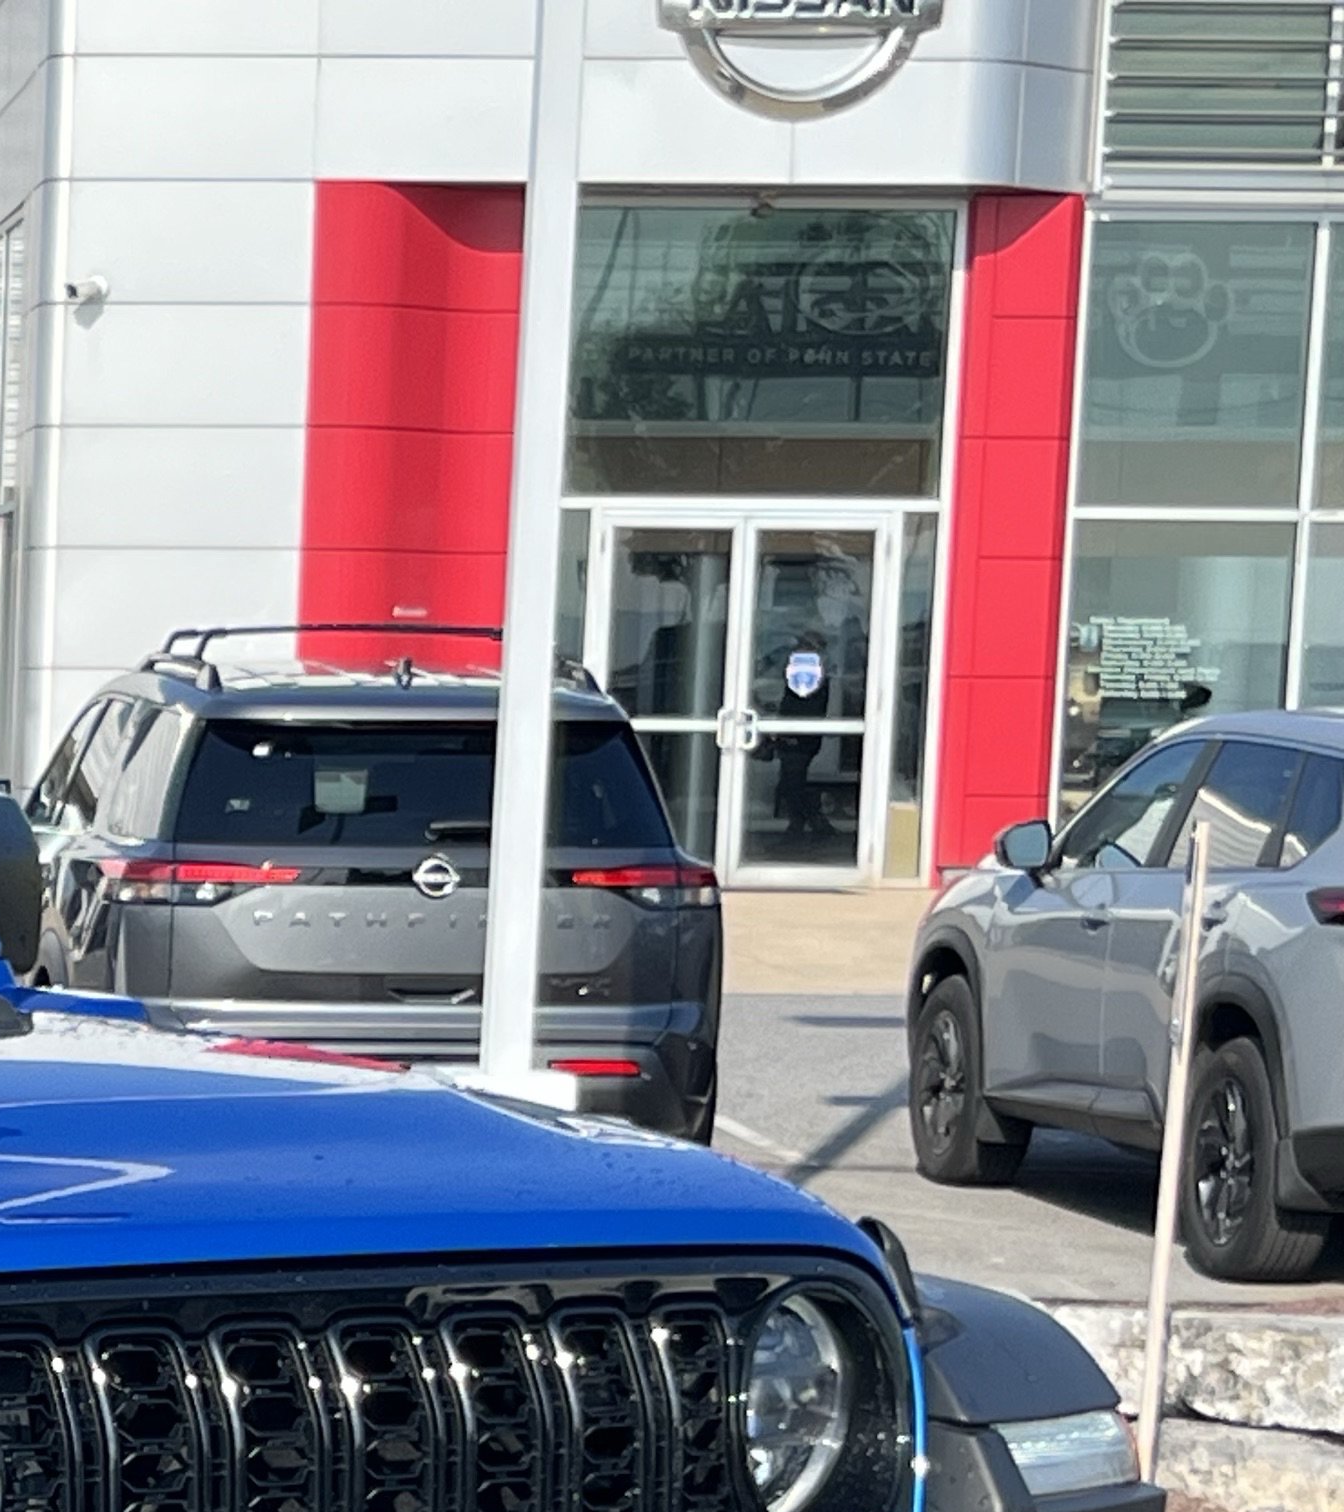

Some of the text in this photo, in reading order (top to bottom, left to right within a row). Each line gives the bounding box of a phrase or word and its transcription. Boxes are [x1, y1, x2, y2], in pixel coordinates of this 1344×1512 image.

[747, 347, 776, 364] OF
[862, 349, 931, 366] STATE
[252, 909, 612, 930] PATHFIER
